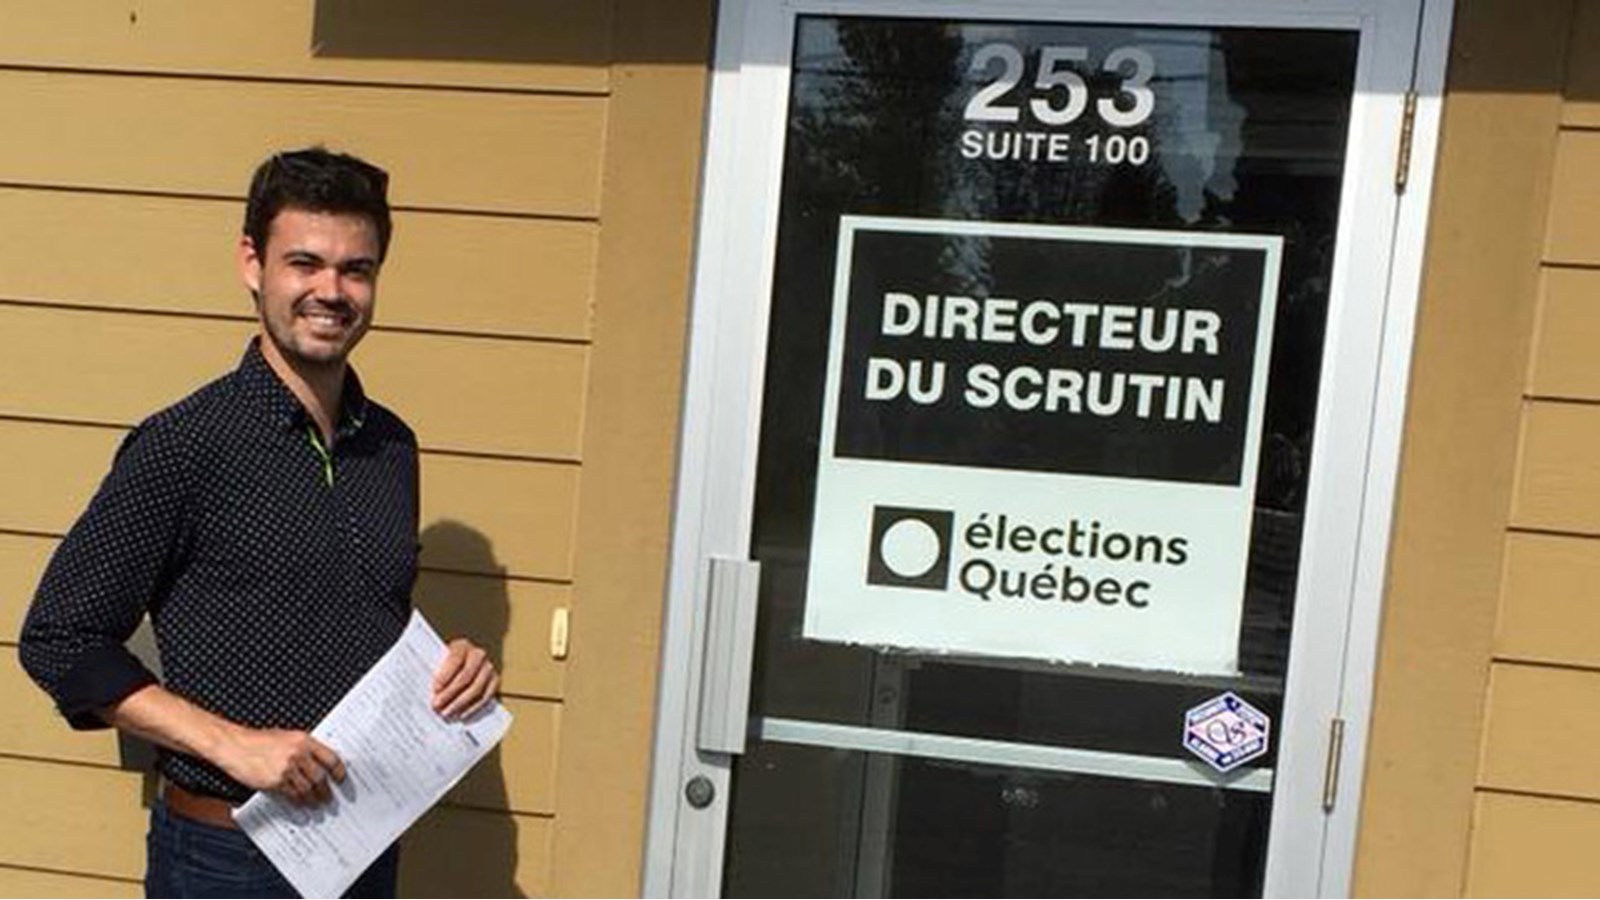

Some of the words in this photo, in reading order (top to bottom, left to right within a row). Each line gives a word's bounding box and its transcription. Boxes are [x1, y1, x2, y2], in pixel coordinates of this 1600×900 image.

[963, 43, 1155, 127] 253
[961, 130, 1070, 161] SUITE
[1085, 134, 1150, 165] 100
[881, 292, 1221, 354] DIRECTEUR
[865, 358, 945, 403] DU
[964, 364, 1224, 422] SCRUTIN
[964, 513, 1189, 565] élections
[958, 559, 1151, 608] Québec
